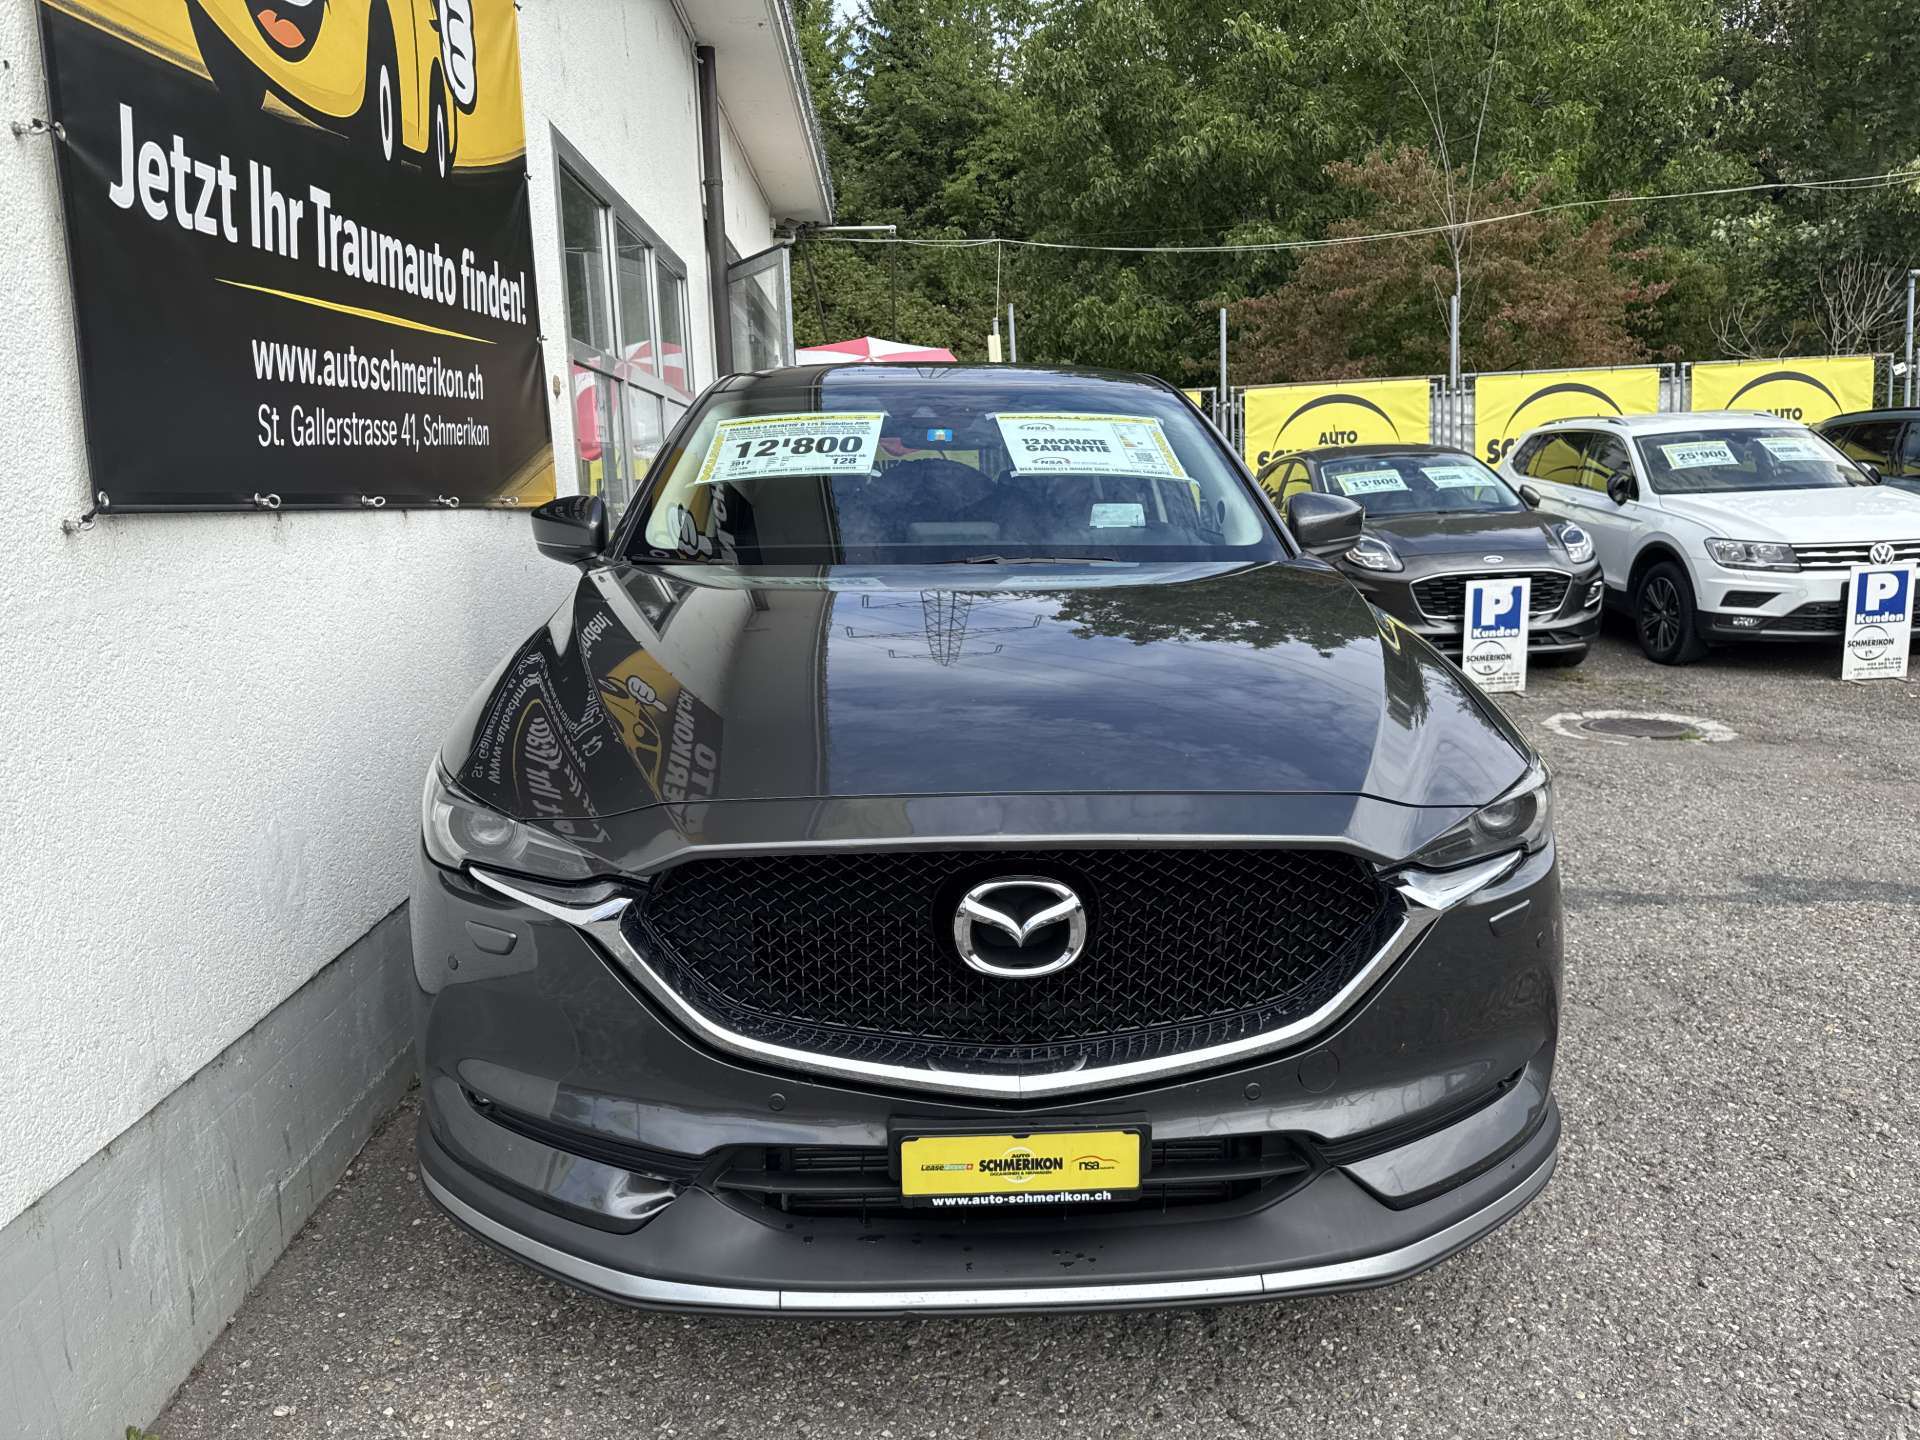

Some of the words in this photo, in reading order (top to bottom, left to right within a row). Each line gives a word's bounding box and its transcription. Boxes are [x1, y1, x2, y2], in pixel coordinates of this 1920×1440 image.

[109, 102, 238, 244] Jetzt
[249, 159, 304, 261] Ihr
[309, 184, 457, 307] Traumauto
[460, 247, 528, 326] finden!
[251, 339, 484, 401] www.autoschmerikon.ch
[257, 403, 285, 448] St.
[290, 404, 398, 448] Gallerstrasse
[401, 412, 420, 453] 41,
[423, 413, 490, 447] Schmerikon
[1021, 438, 1041, 446] 12
[1043, 437, 1108, 447] MONATE
[1318, 430, 1358, 445] AUTO
[735, 436, 863, 458] 12'800
[1025, 444, 1112, 453] GARANTIE
[832, 457, 857, 465] 128
[1677, 449, 1728, 460] 25'900
[1865, 573, 1900, 611] P
[1481, 585, 1514, 626] P
[1855, 611, 1904, 624] Kunden
[1472, 627, 1519, 638] Kunden
[1847, 638, 1894, 648] SCHMERIKON
[1466, 653, 1512, 662] SCHMERIKON
[979, 1157, 1063, 1172] SCHMERIKON
[1079, 1161, 1100, 1171] nsa
[932, 1190, 1112, 1206] www.auto-schmerikon.ch
